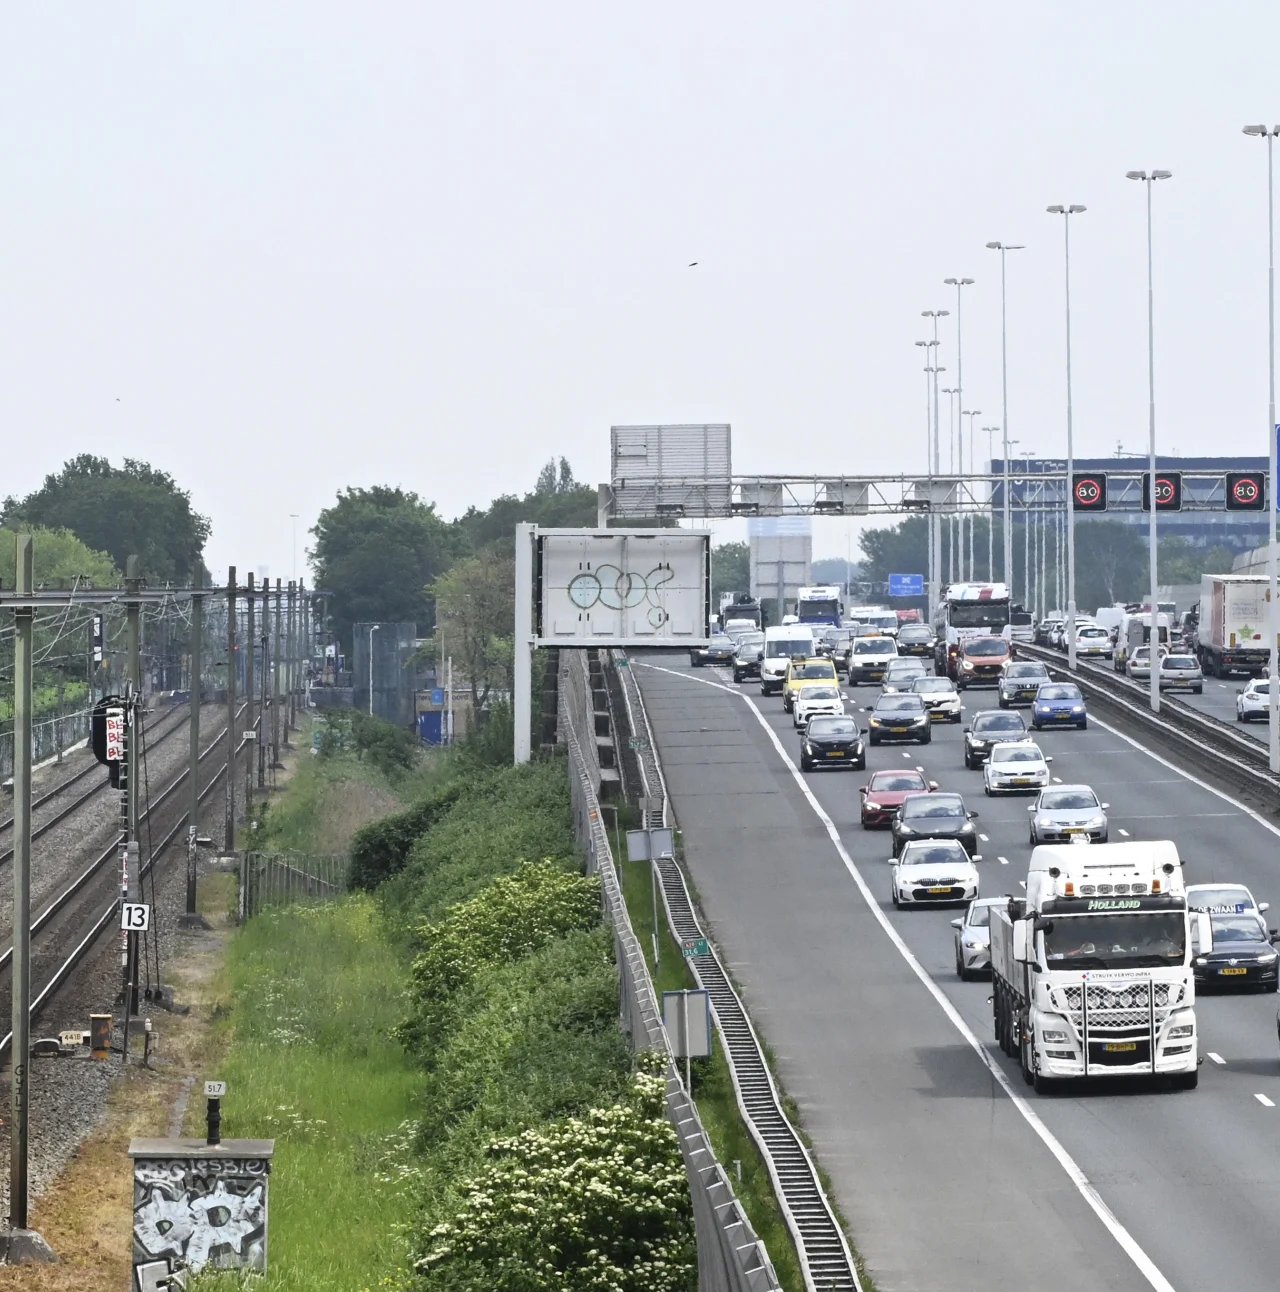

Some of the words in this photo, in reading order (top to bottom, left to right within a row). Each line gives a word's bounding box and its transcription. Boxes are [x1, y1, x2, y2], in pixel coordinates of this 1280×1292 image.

[1078, 487, 1097, 497] 80
[1154, 486, 1171, 497] 80
[1236, 486, 1255, 497] 80
[125, 906, 146, 928] 13
